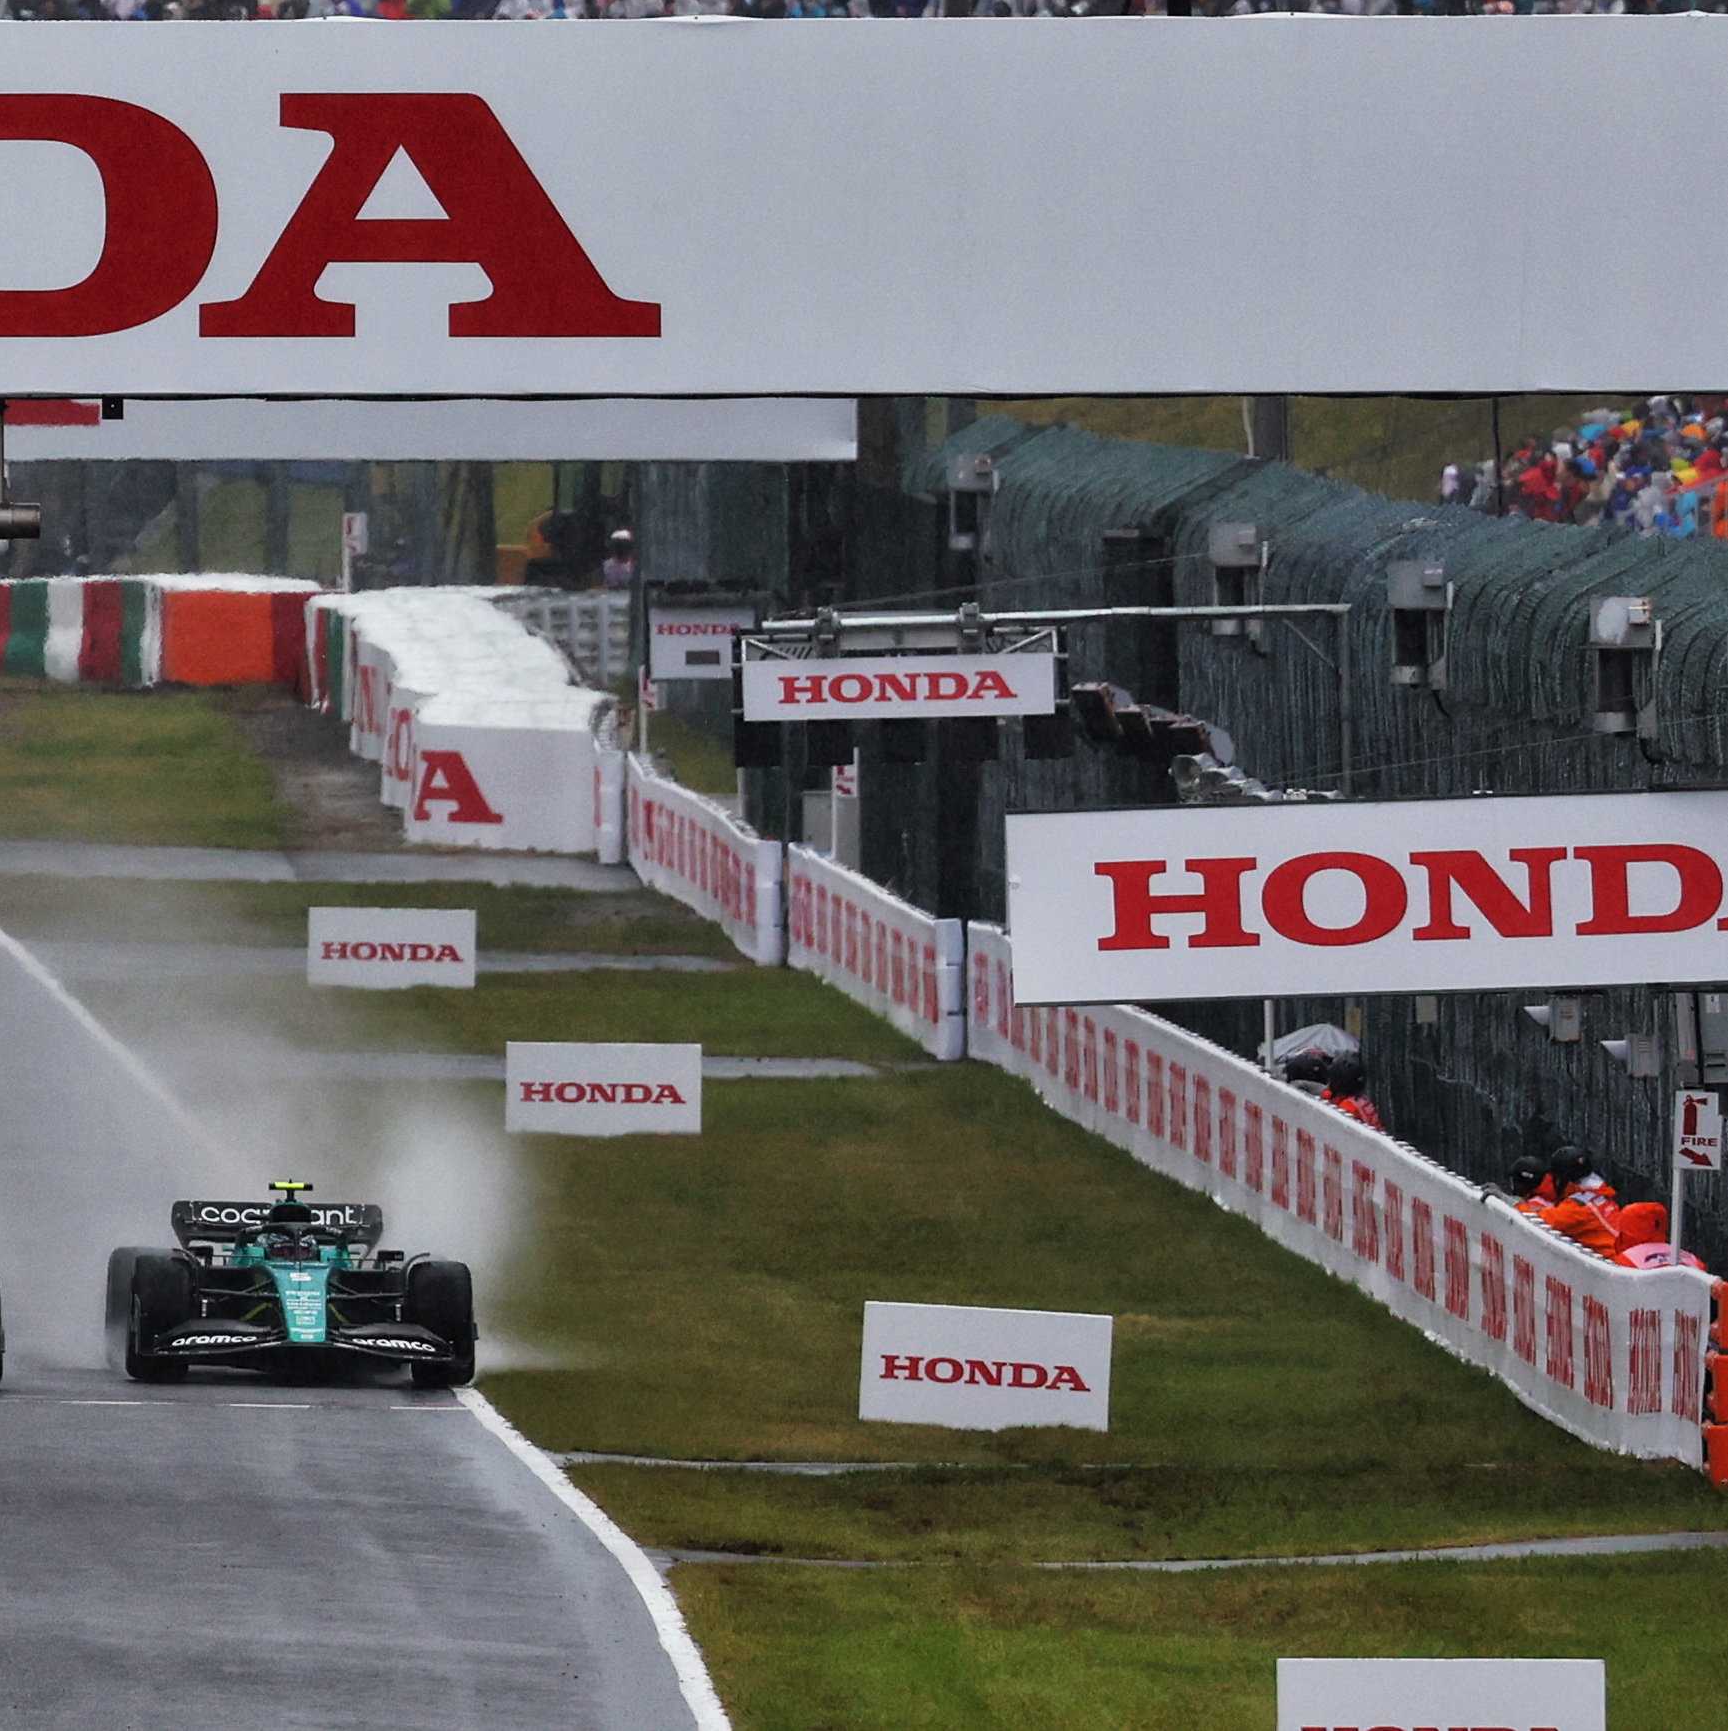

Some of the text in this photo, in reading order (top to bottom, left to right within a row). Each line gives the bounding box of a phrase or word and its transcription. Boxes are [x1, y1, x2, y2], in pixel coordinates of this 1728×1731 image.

[778, 670, 1018, 706] HONDA
[1094, 843, 1728, 952] HOND
[321, 941, 463, 965] HONDA
[520, 1082, 686, 1106] HONDA
[1680, 1136, 1718, 1147] FIRE
[171, 1334, 257, 1347] aramco
[352, 1336, 436, 1352] aramco
[879, 1354, 1091, 1393] HONDA
